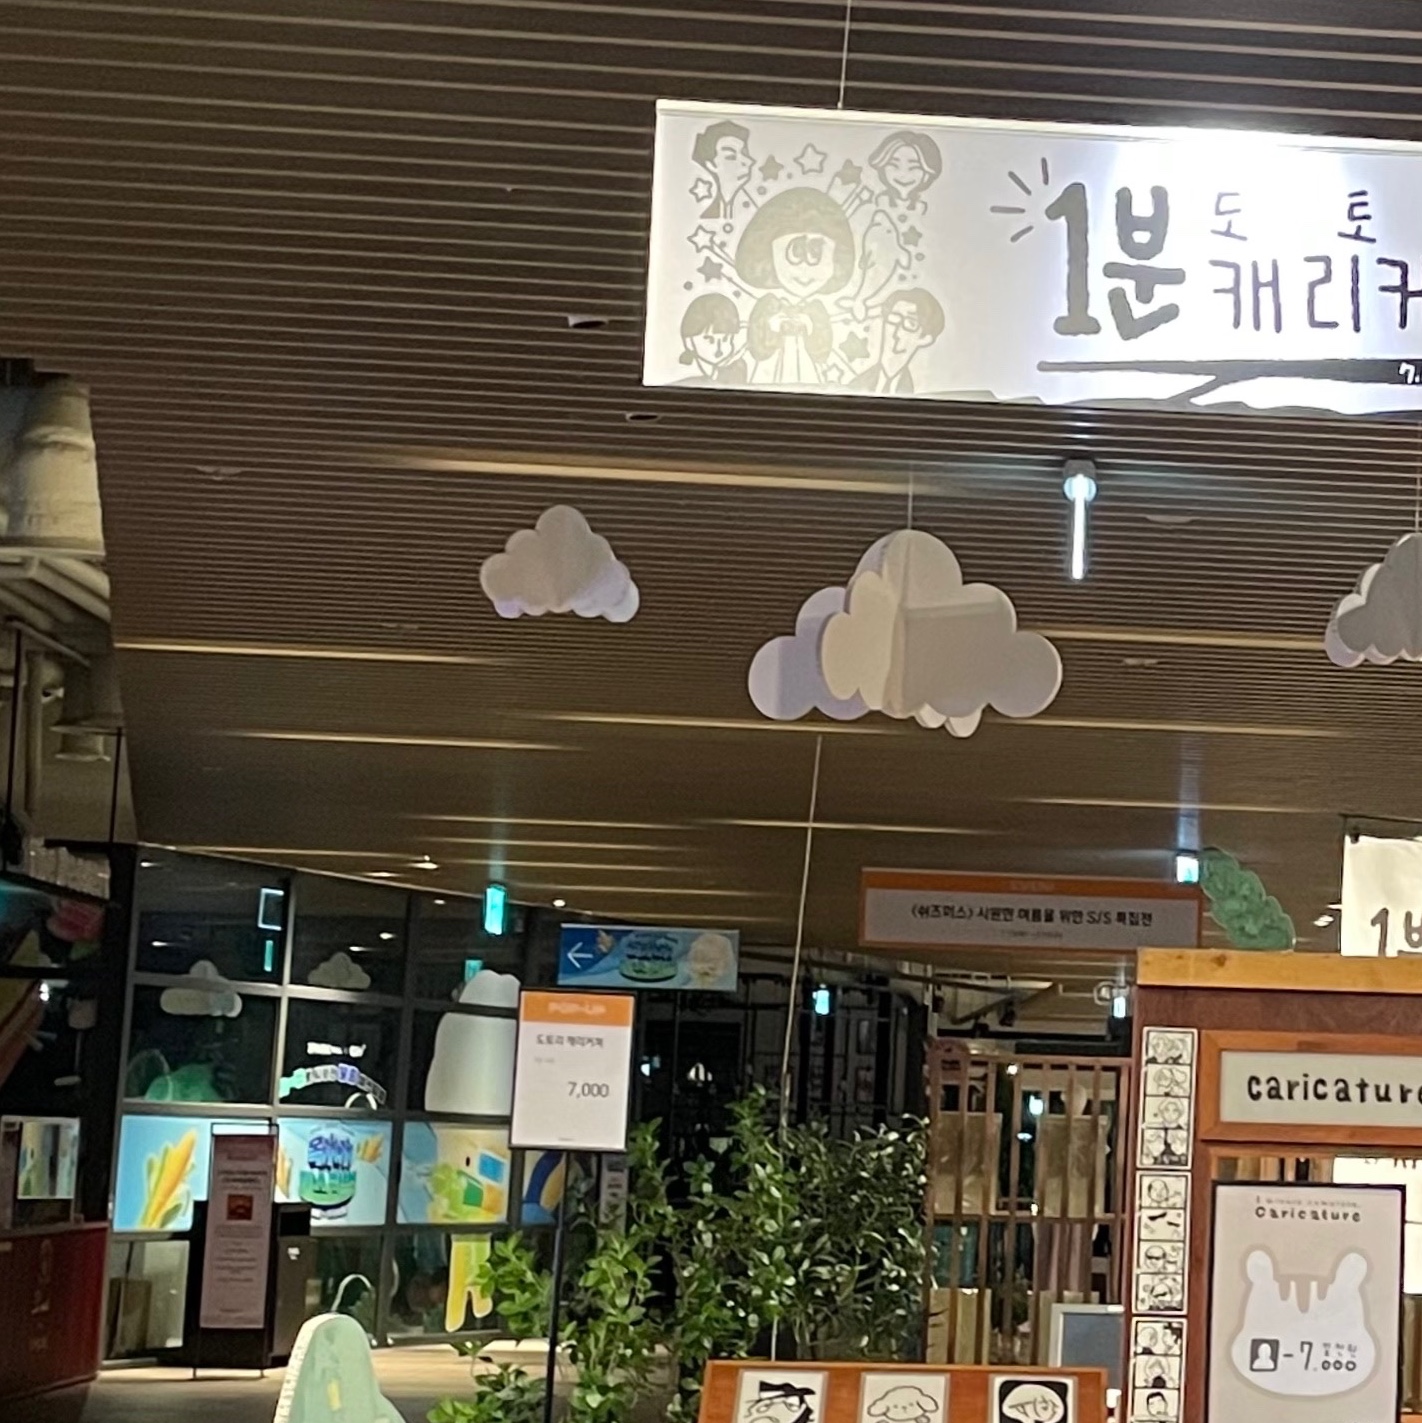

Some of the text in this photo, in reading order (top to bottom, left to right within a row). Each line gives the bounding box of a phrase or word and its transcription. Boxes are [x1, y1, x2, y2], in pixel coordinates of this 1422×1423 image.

[1044, 181, 1187, 341] 1분
[567, 1081, 610, 1098] 7,000
[1255, 1206, 1361, 1222] Caricature
